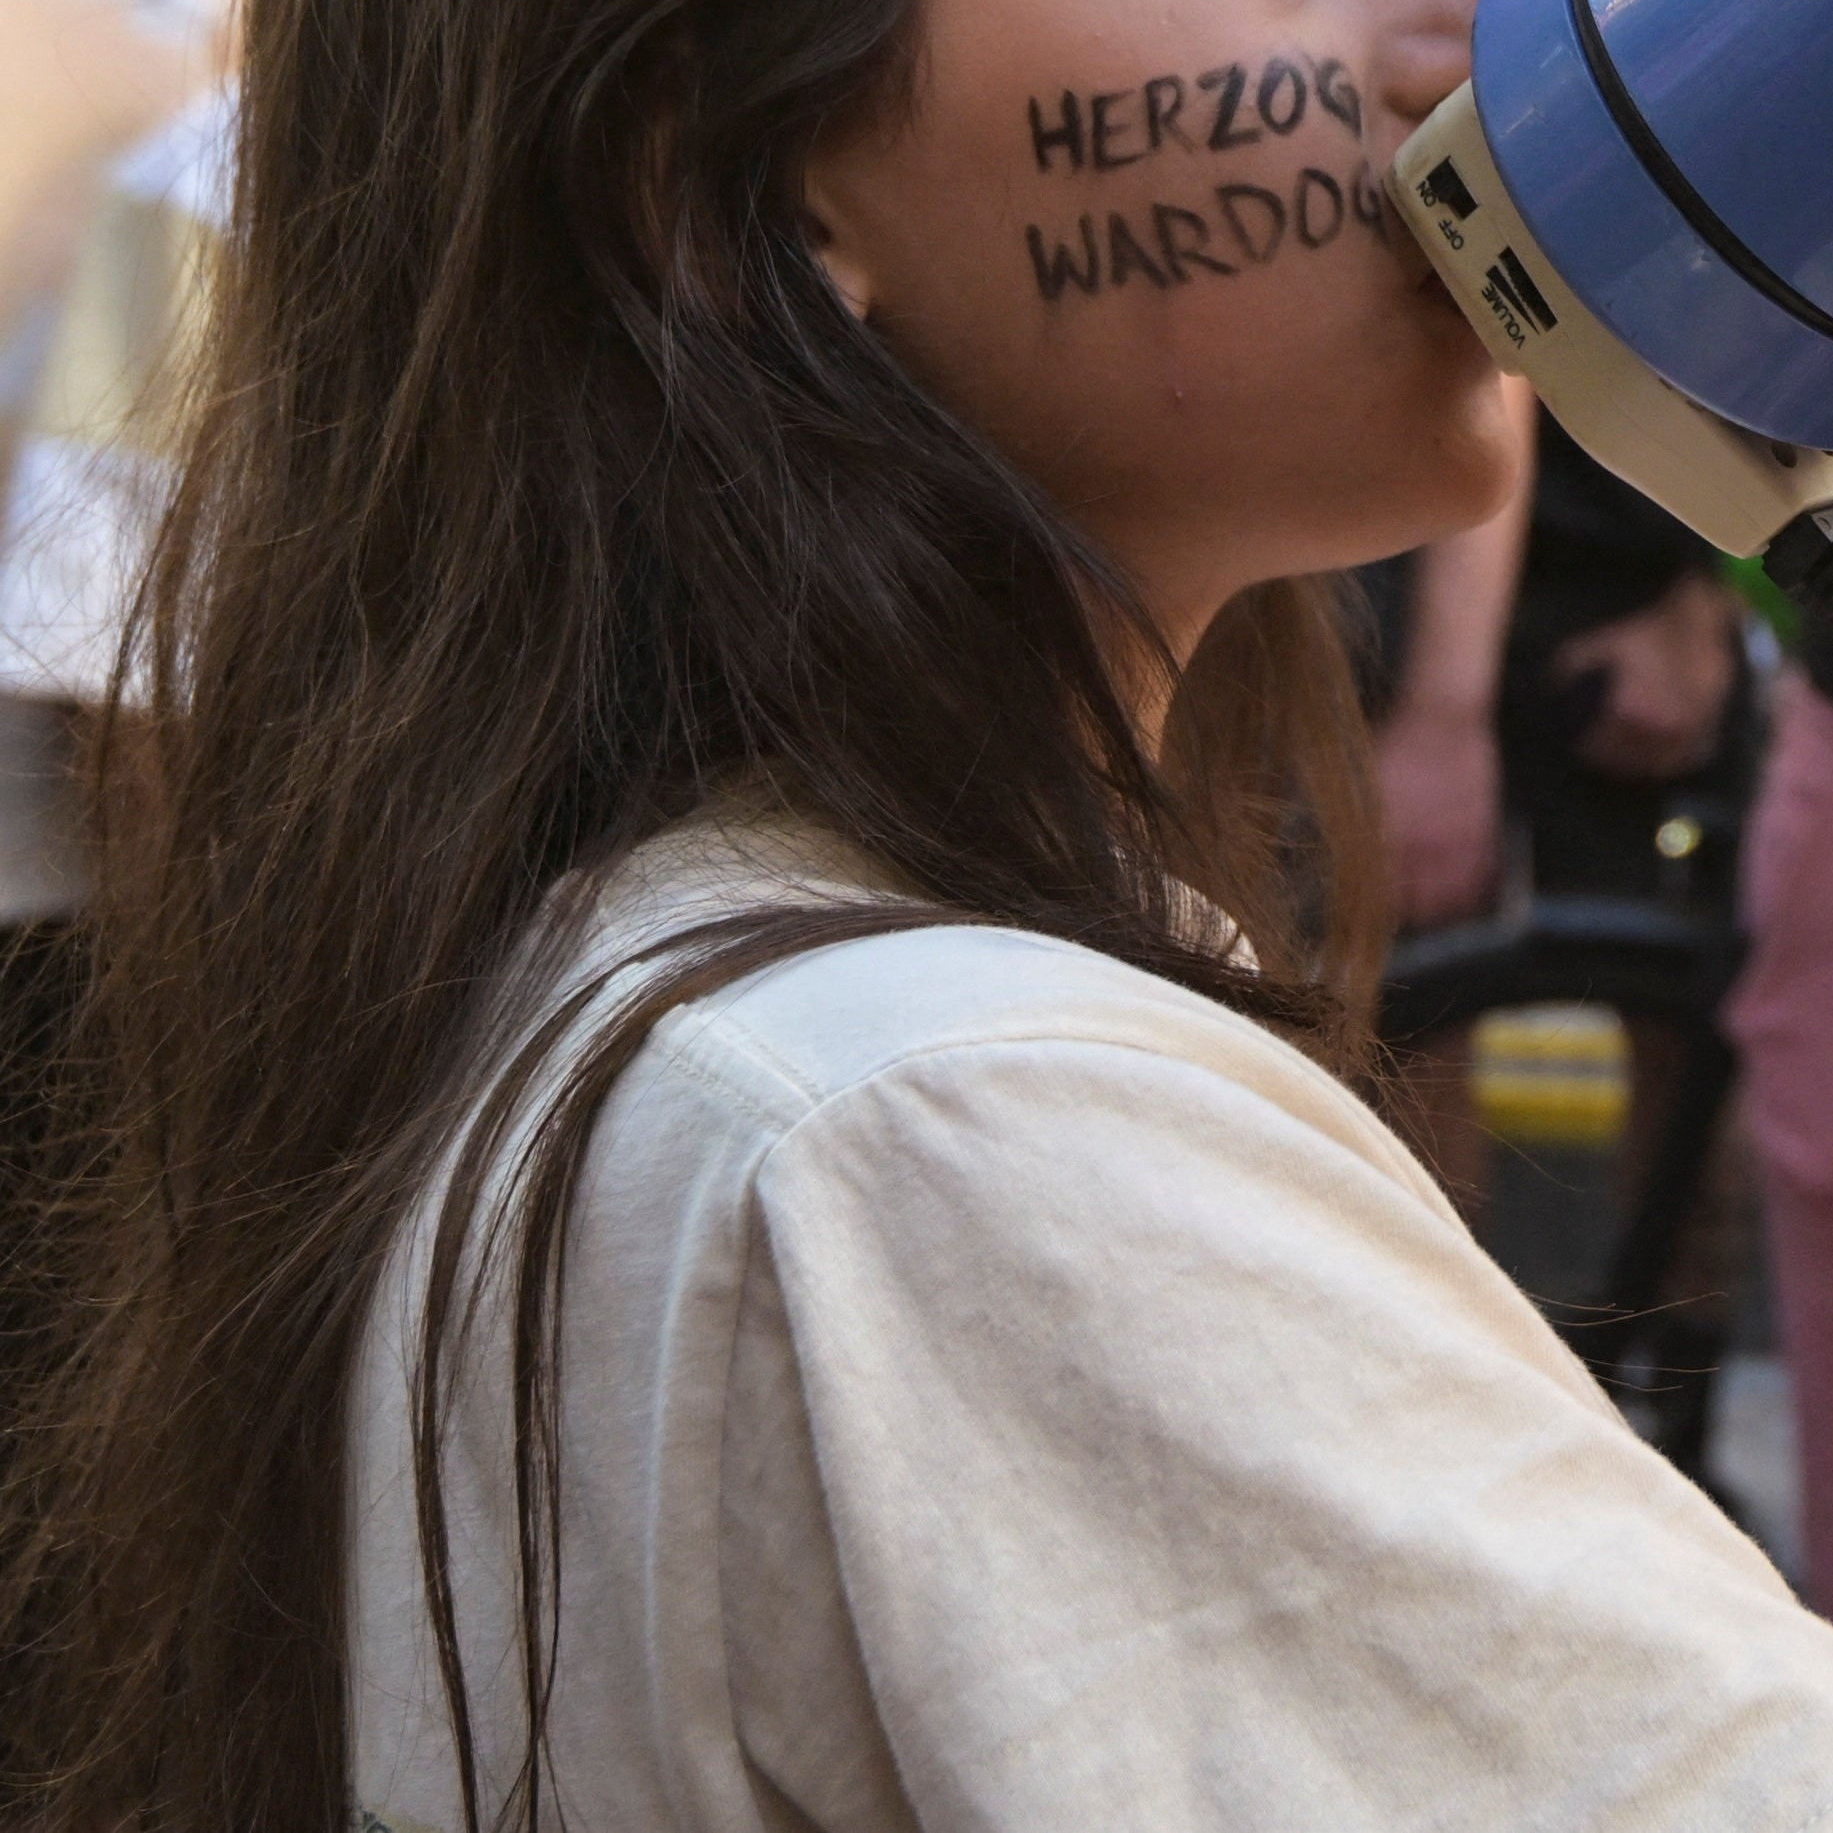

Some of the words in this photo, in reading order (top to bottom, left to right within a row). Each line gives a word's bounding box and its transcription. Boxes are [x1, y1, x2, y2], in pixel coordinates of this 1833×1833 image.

[1027, 56, 1362, 174] HERZOG
[1416, 180, 1436, 207] ON
[1438, 219, 1464, 250] OFF
[1481, 282, 1526, 350] VOLUME
